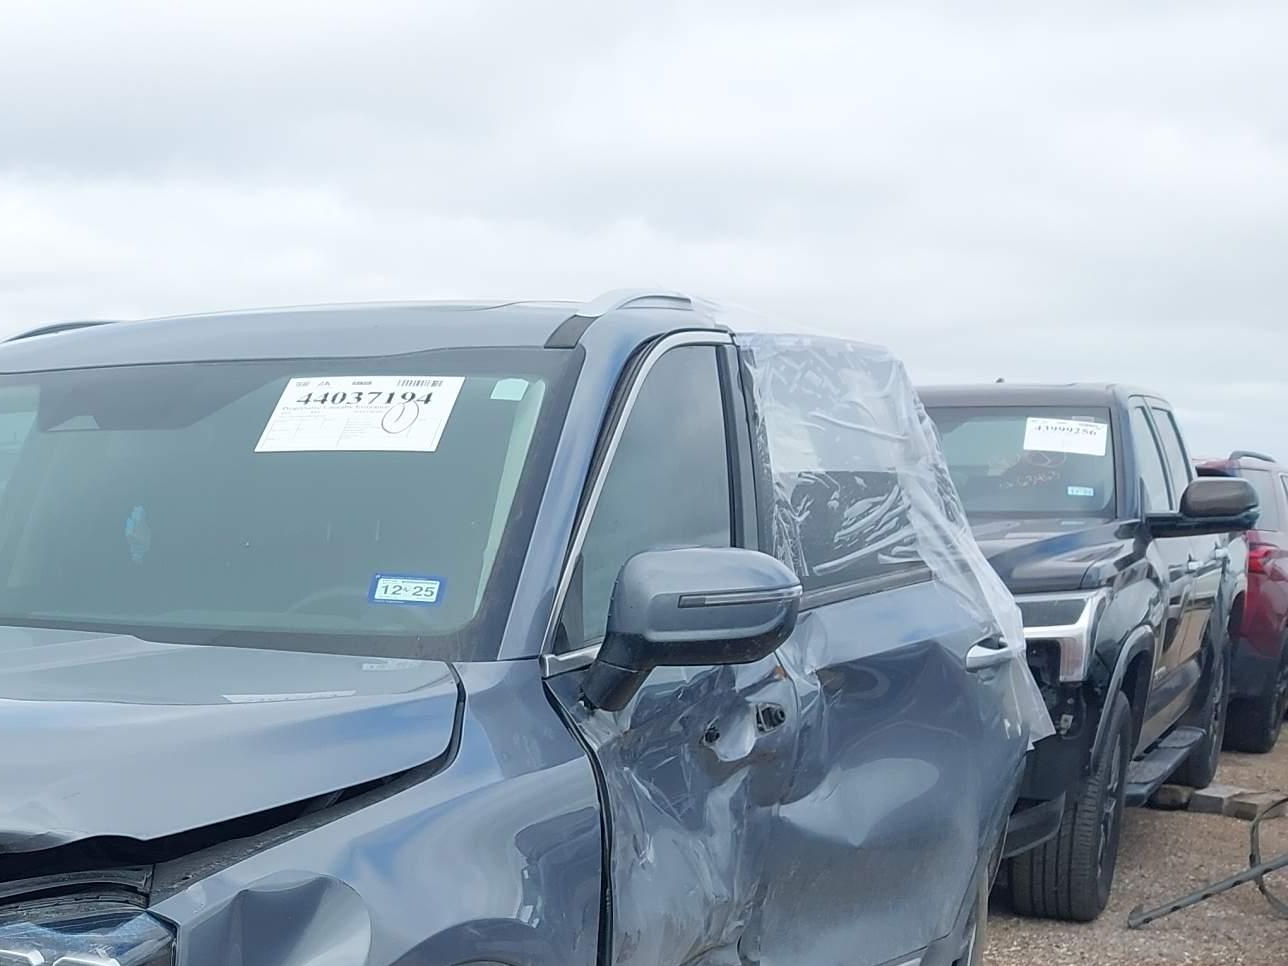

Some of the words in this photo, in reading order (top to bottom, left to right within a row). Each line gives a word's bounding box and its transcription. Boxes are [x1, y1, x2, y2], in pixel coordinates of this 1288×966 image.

[296, 391, 433, 405] 44037194
[381, 584, 403, 596] 12
[412, 585, 436, 597] 25
